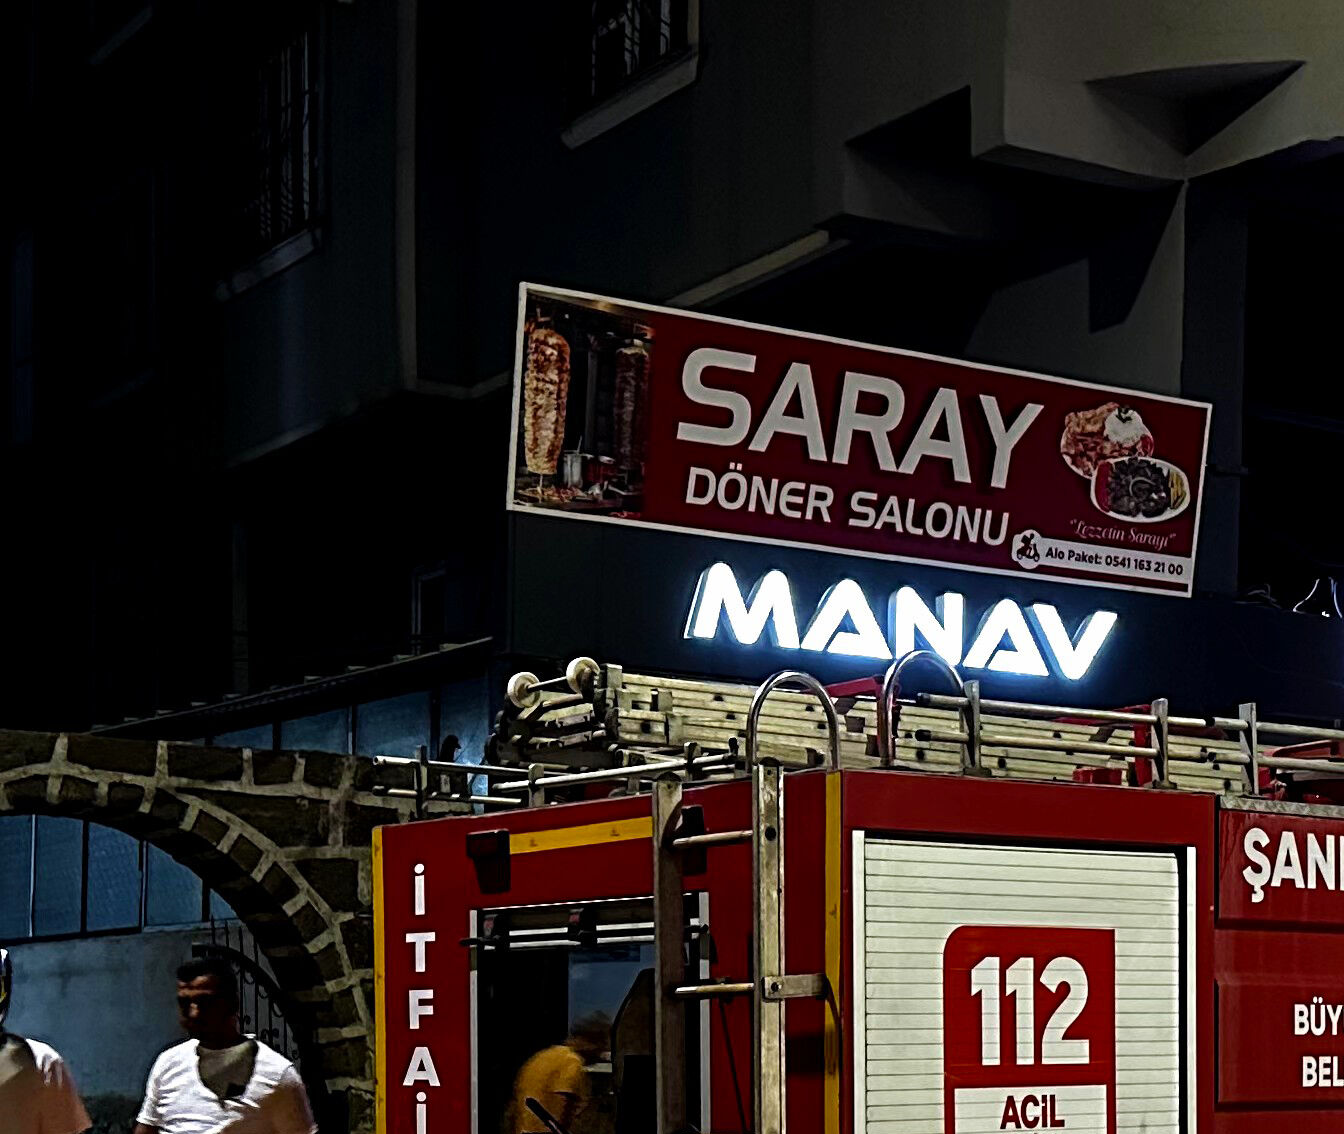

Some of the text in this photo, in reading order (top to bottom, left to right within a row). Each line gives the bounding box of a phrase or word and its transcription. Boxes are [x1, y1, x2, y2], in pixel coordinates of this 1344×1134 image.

[676, 346, 1045, 489] SARAY
[685, 462, 1010, 546] DÖNER SALONU
[1045, 547, 1184, 576] Alo Paket: 0541 163 21 00
[682, 560, 1118, 681] MANAV
[971, 956, 1090, 1066] 112
[1000, 1094, 1065, 1130] ACİL
